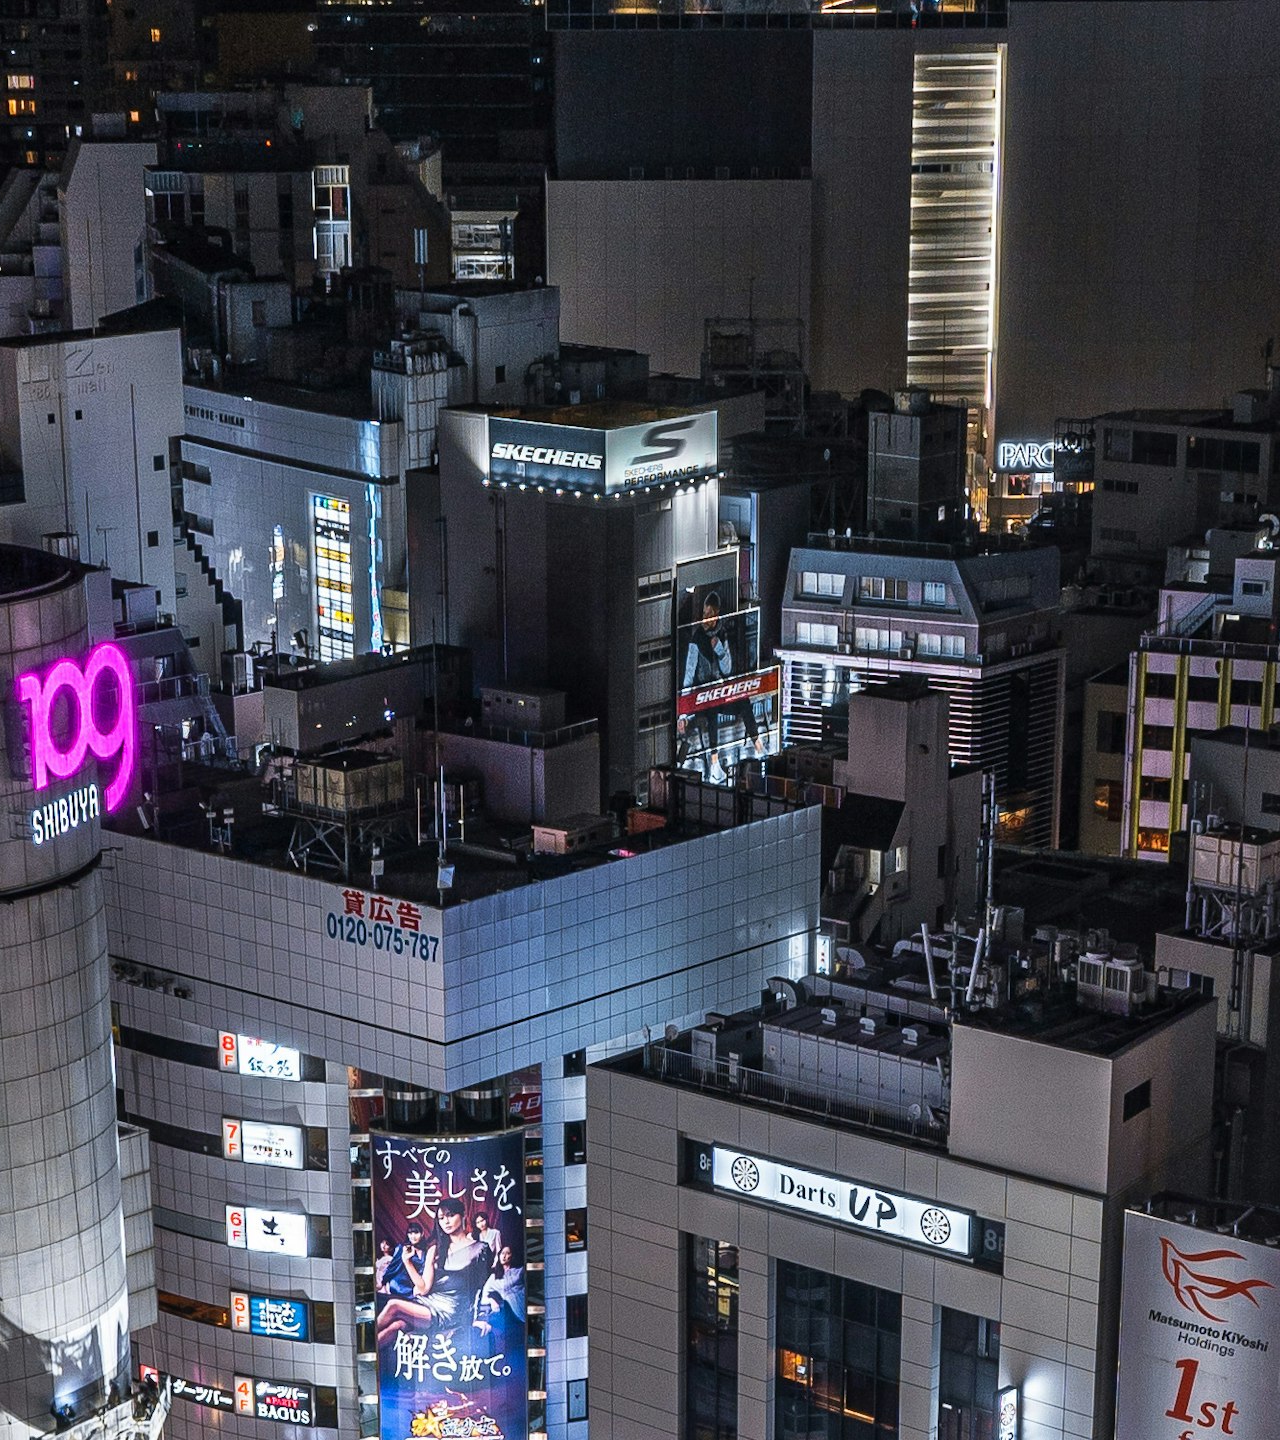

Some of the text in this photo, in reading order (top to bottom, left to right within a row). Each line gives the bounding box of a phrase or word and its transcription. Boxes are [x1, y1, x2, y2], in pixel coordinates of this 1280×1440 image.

[491, 443, 603, 470] SKECHERS
[624, 463, 664, 478] SKECHERS
[624, 464, 699, 487] PERFORMANCE
[695, 677, 762, 705] SKECHERS
[18, 643, 134, 812] 109
[32, 783, 99, 845] SHIBUYA
[342, 889, 422, 931] 貸広告
[326, 912, 439, 962] 0120-075-787
[221, 1034, 235, 1067] 8F
[226, 1124, 238, 1157] 7F
[376, 1140, 451, 1180] すべての
[700, 1153, 712, 1172] 8F
[404, 1165, 522, 1219] 美しさを、
[780, 1173, 897, 1228] Darts UP
[230, 1211, 241, 1241] 6F
[234, 1297, 245, 1329] 5F
[1148, 1309, 1269, 1352] Matsumoto KiYoshi
[1178, 1331, 1235, 1358] Holdings
[393, 1329, 512, 1382] 解き放て。
[172, 1379, 233, 1407] ダーツバー
[238, 1382, 250, 1411] 4F
[255, 1380, 309, 1400] ダーツバー
[1165, 1358, 1239, 1435] 1st
[258, 1402, 311, 1425] BAGUS
